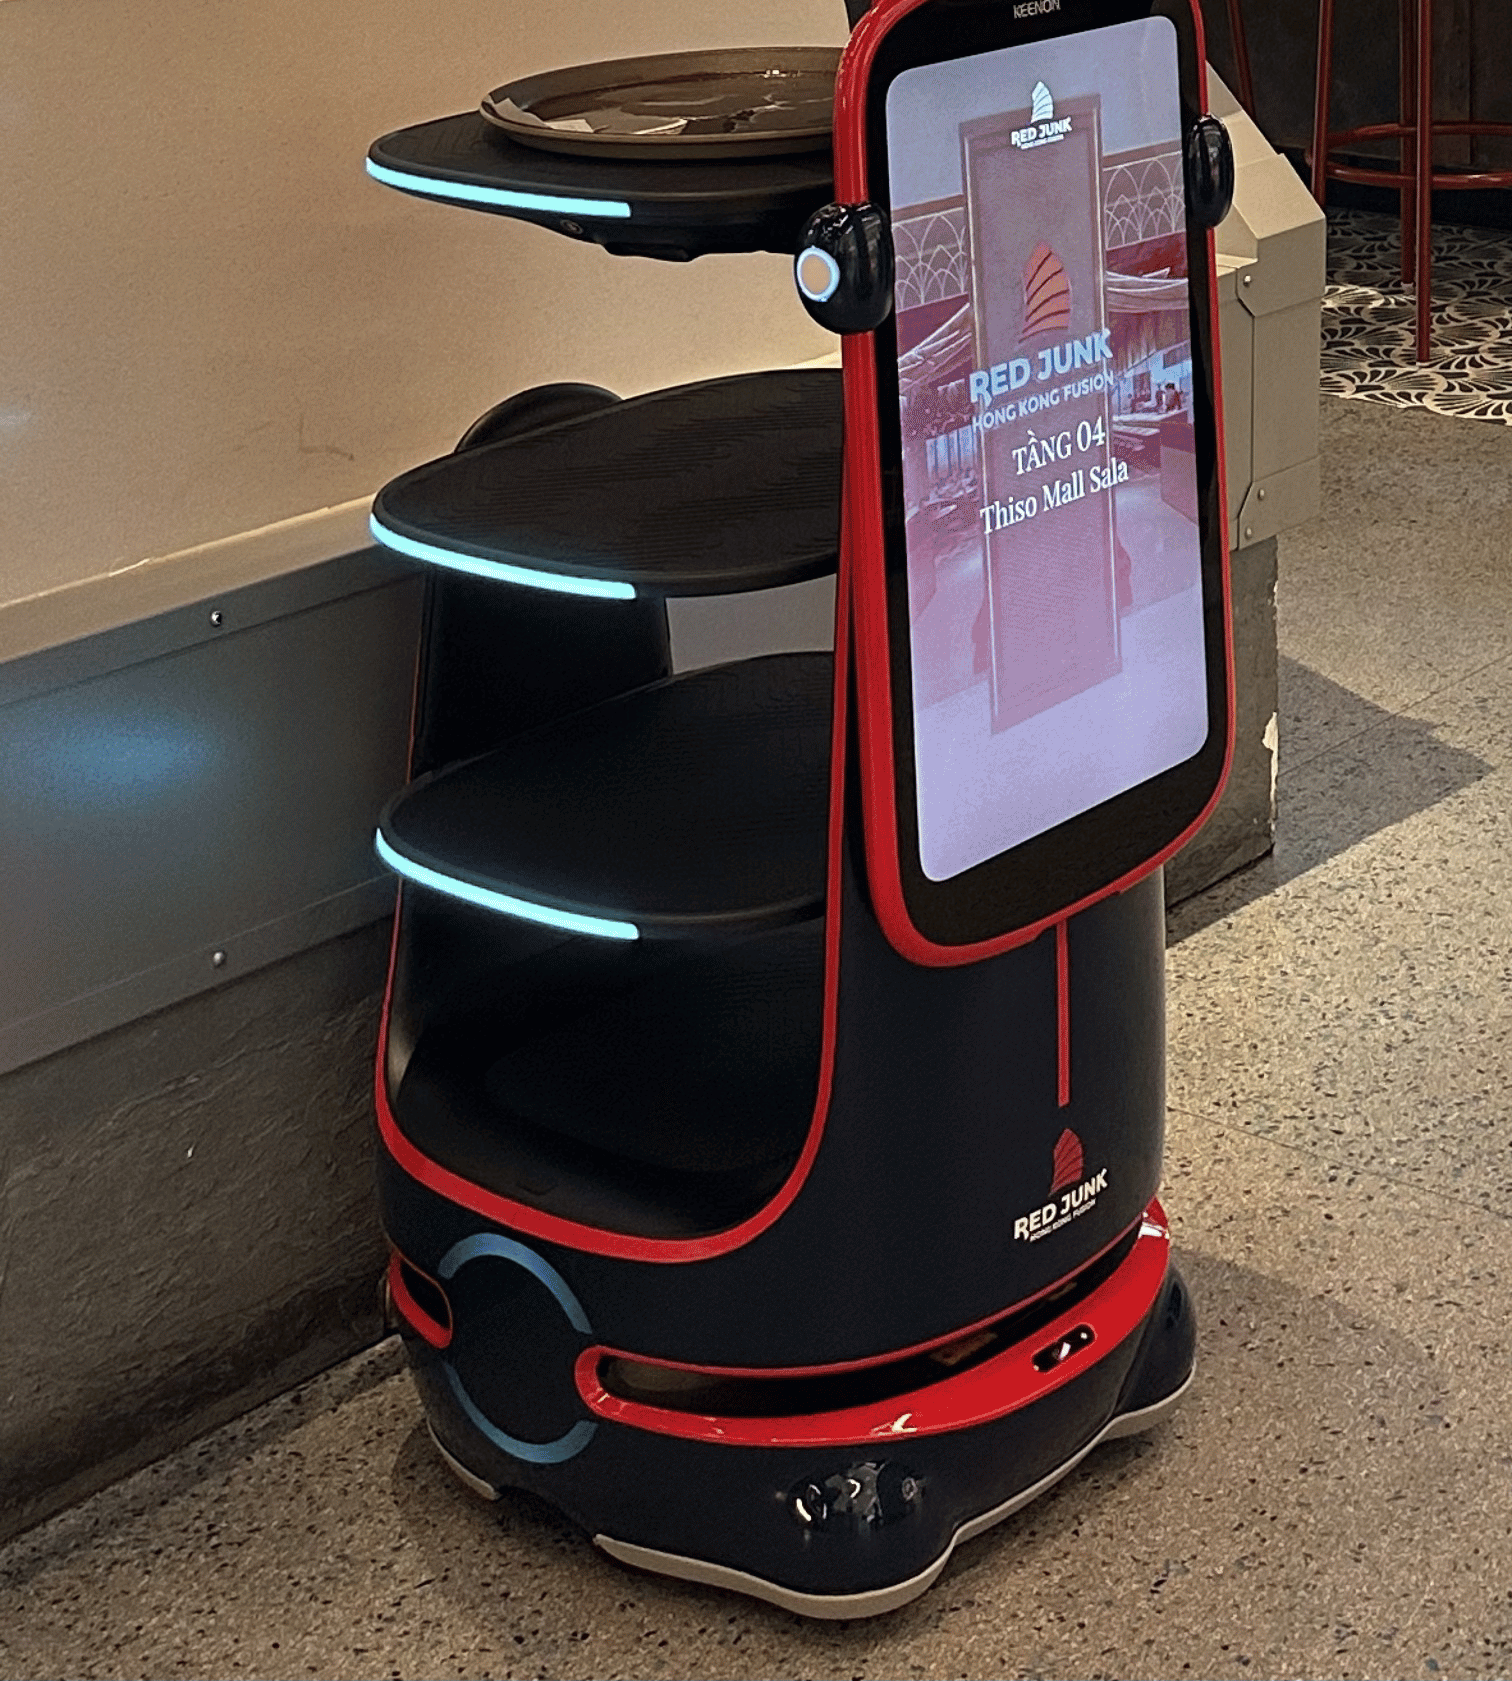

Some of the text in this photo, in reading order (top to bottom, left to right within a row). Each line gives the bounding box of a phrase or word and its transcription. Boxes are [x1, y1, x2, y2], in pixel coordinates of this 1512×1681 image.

[1011, 127, 1037, 148] RED
[1038, 116, 1073, 138] JUNK
[969, 327, 1113, 408] RED JUNK
[972, 370, 1115, 434] HONG KONG FUSION
[1011, 416, 1106, 476] TẦNG 04
[979, 457, 1129, 535] Thiso Mall Sala
[1013, 1167, 1108, 1240] RED JUNK
